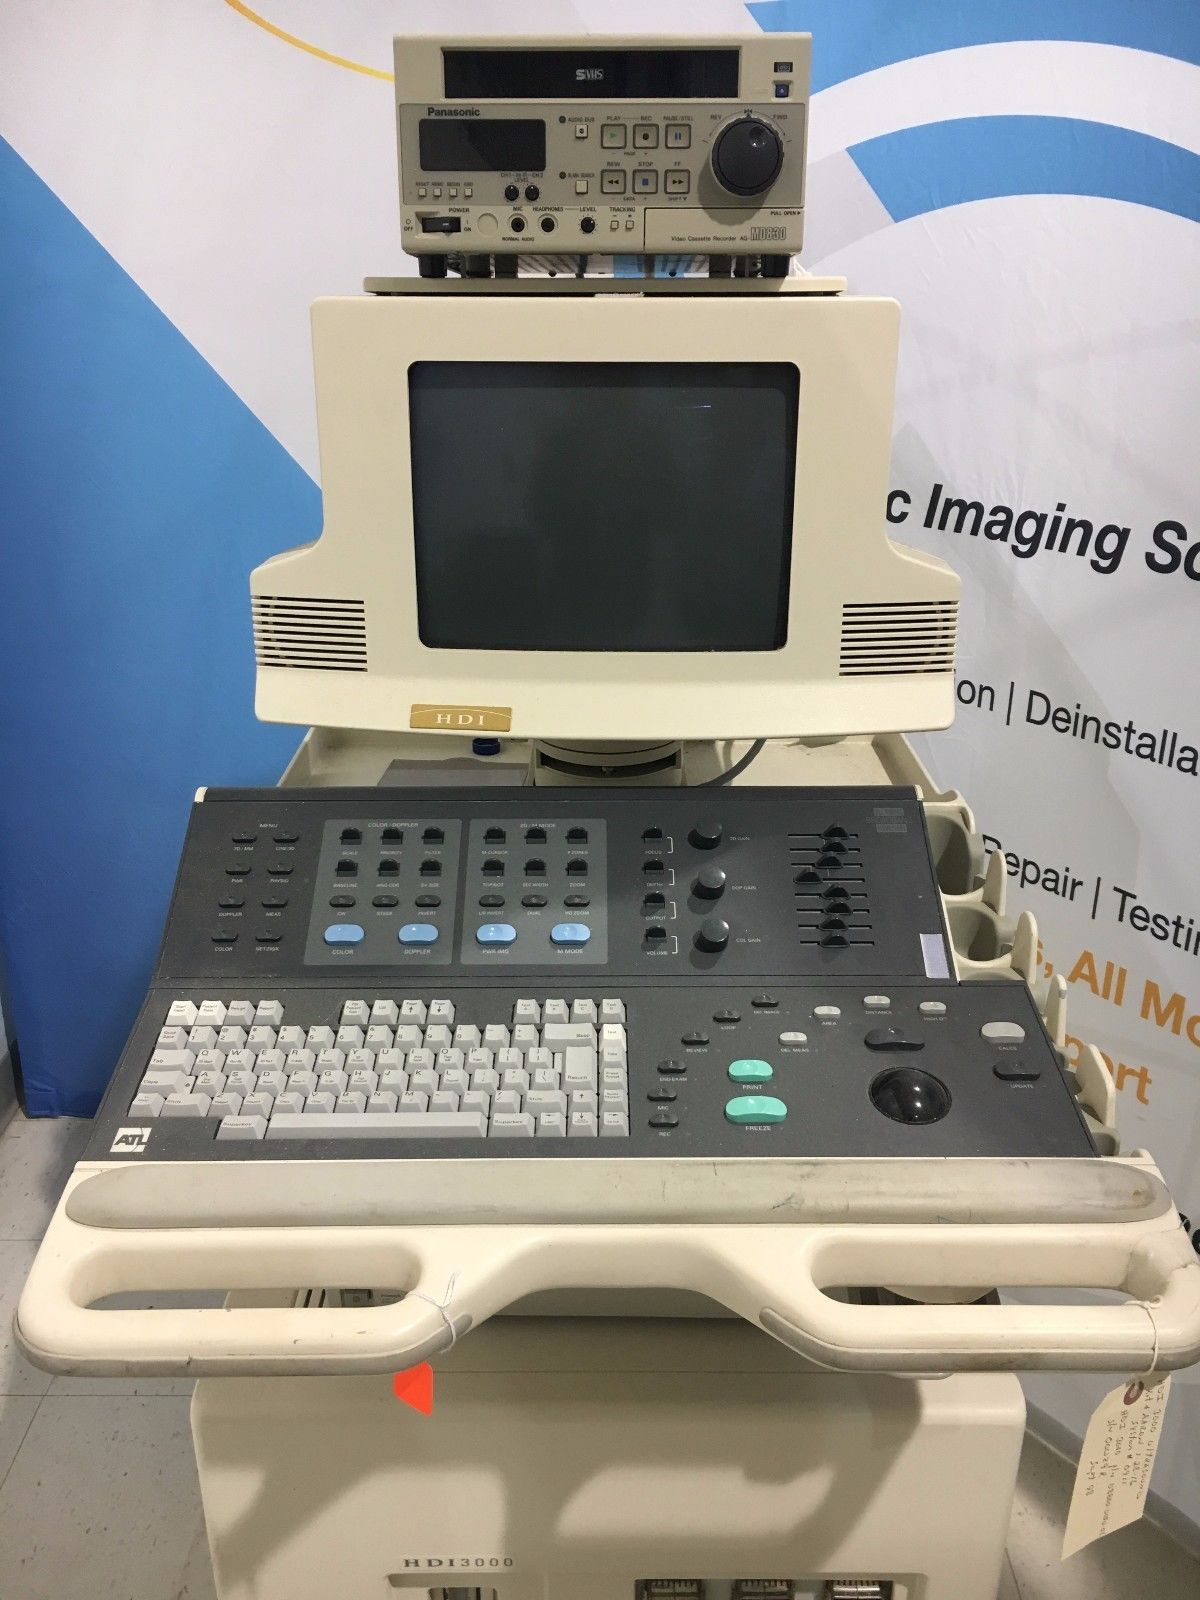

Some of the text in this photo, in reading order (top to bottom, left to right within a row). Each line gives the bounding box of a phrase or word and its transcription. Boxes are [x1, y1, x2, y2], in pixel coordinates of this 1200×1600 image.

[427, 107, 481, 117] Panasonic
[923, 482, 1132, 574] Imaging
[436, 713, 485, 726] HDI
[956, 679, 1200, 777] on Deinstalla
[1067, 950, 1128, 1007] All
[112, 1133, 149, 1146] ATL
[403, 1557, 514, 1568] HDI3000
